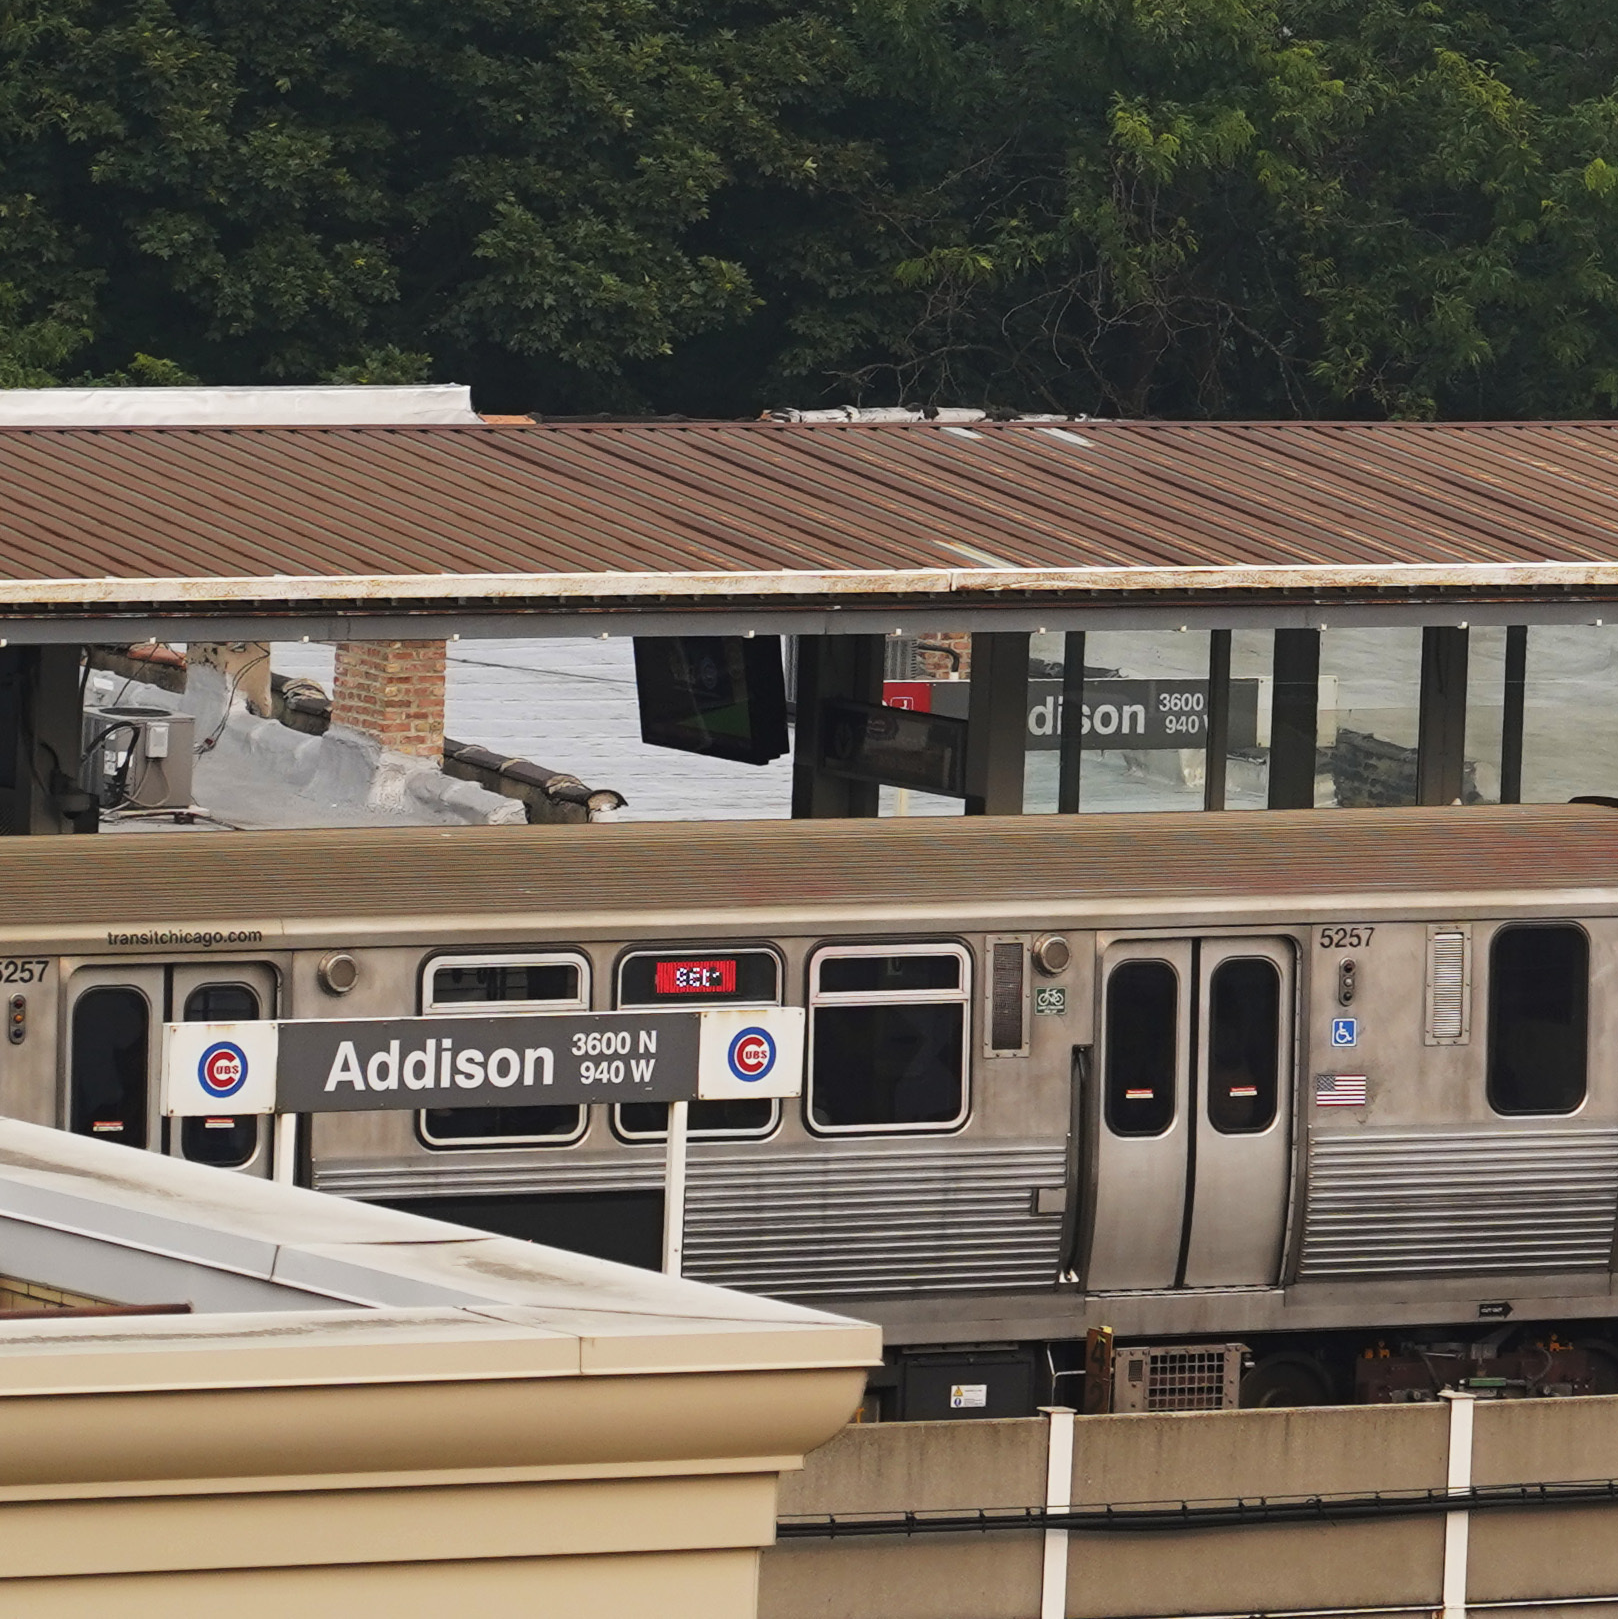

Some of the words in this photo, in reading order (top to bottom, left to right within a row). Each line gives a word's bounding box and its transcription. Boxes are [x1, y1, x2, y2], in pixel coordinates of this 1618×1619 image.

[1159, 693, 1204, 712] 3600
[1165, 715, 1200, 734] 940
[107, 930, 262, 947] transitchicago.com
[1319, 927, 1375, 949] 5257
[0, 960, 49, 983] 257
[571, 1031, 632, 1056] 3600
[638, 1030, 657, 1054] N
[323, 1036, 554, 1092] Addison
[580, 1060, 625, 1085] 940
[630, 1059, 655, 1083] W
